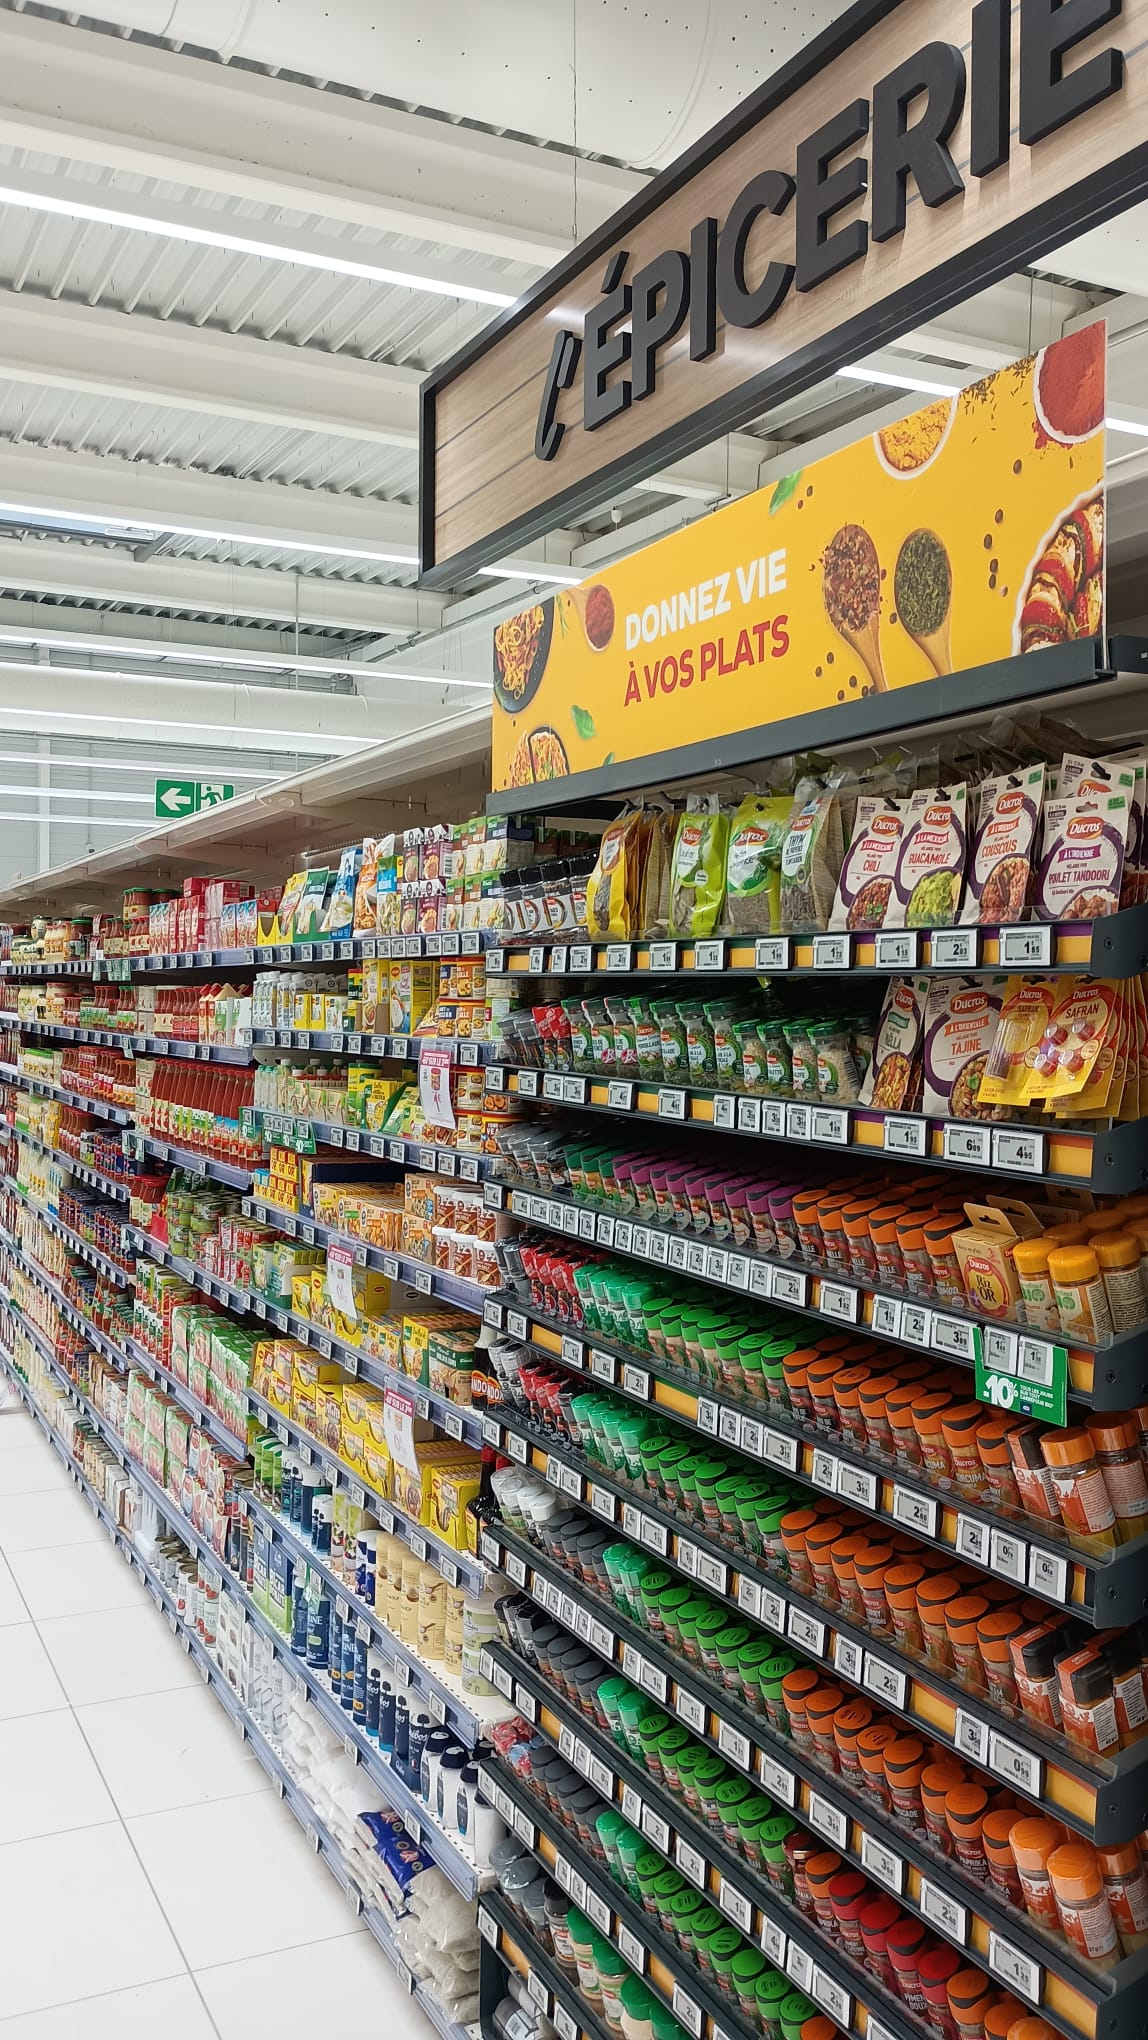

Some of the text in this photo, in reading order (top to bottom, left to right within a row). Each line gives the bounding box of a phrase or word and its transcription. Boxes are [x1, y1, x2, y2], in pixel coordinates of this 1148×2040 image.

[625, 547, 788, 651] DONNEZ VIE
[624, 614, 790, 708] À VOS PLATS
[998, 797, 1023, 811] Ducros
[873, 819, 899, 831] Ducros
[1070, 822, 1101, 835] Ducros
[981, 839, 1018, 859] COUSCOUS
[908, 852, 950, 865] GUACAMOLE
[862, 859, 881, 873] CHILI
[1048, 869, 1110, 885] POULET TANDOORI
[1019, 991, 1043, 999] Ducros
[1072, 988, 1099, 1000] Ducros
[954, 996, 986, 1011] Ducros
[1064, 1002, 1100, 1020] SAFRAN
[951, 1038, 981, 1056] TAJINE
[969, 1258, 990, 1271] Ducros
[976, 1274, 992, 1290] Riz
[959, 1856, 988, 1867] PAPRIKA
